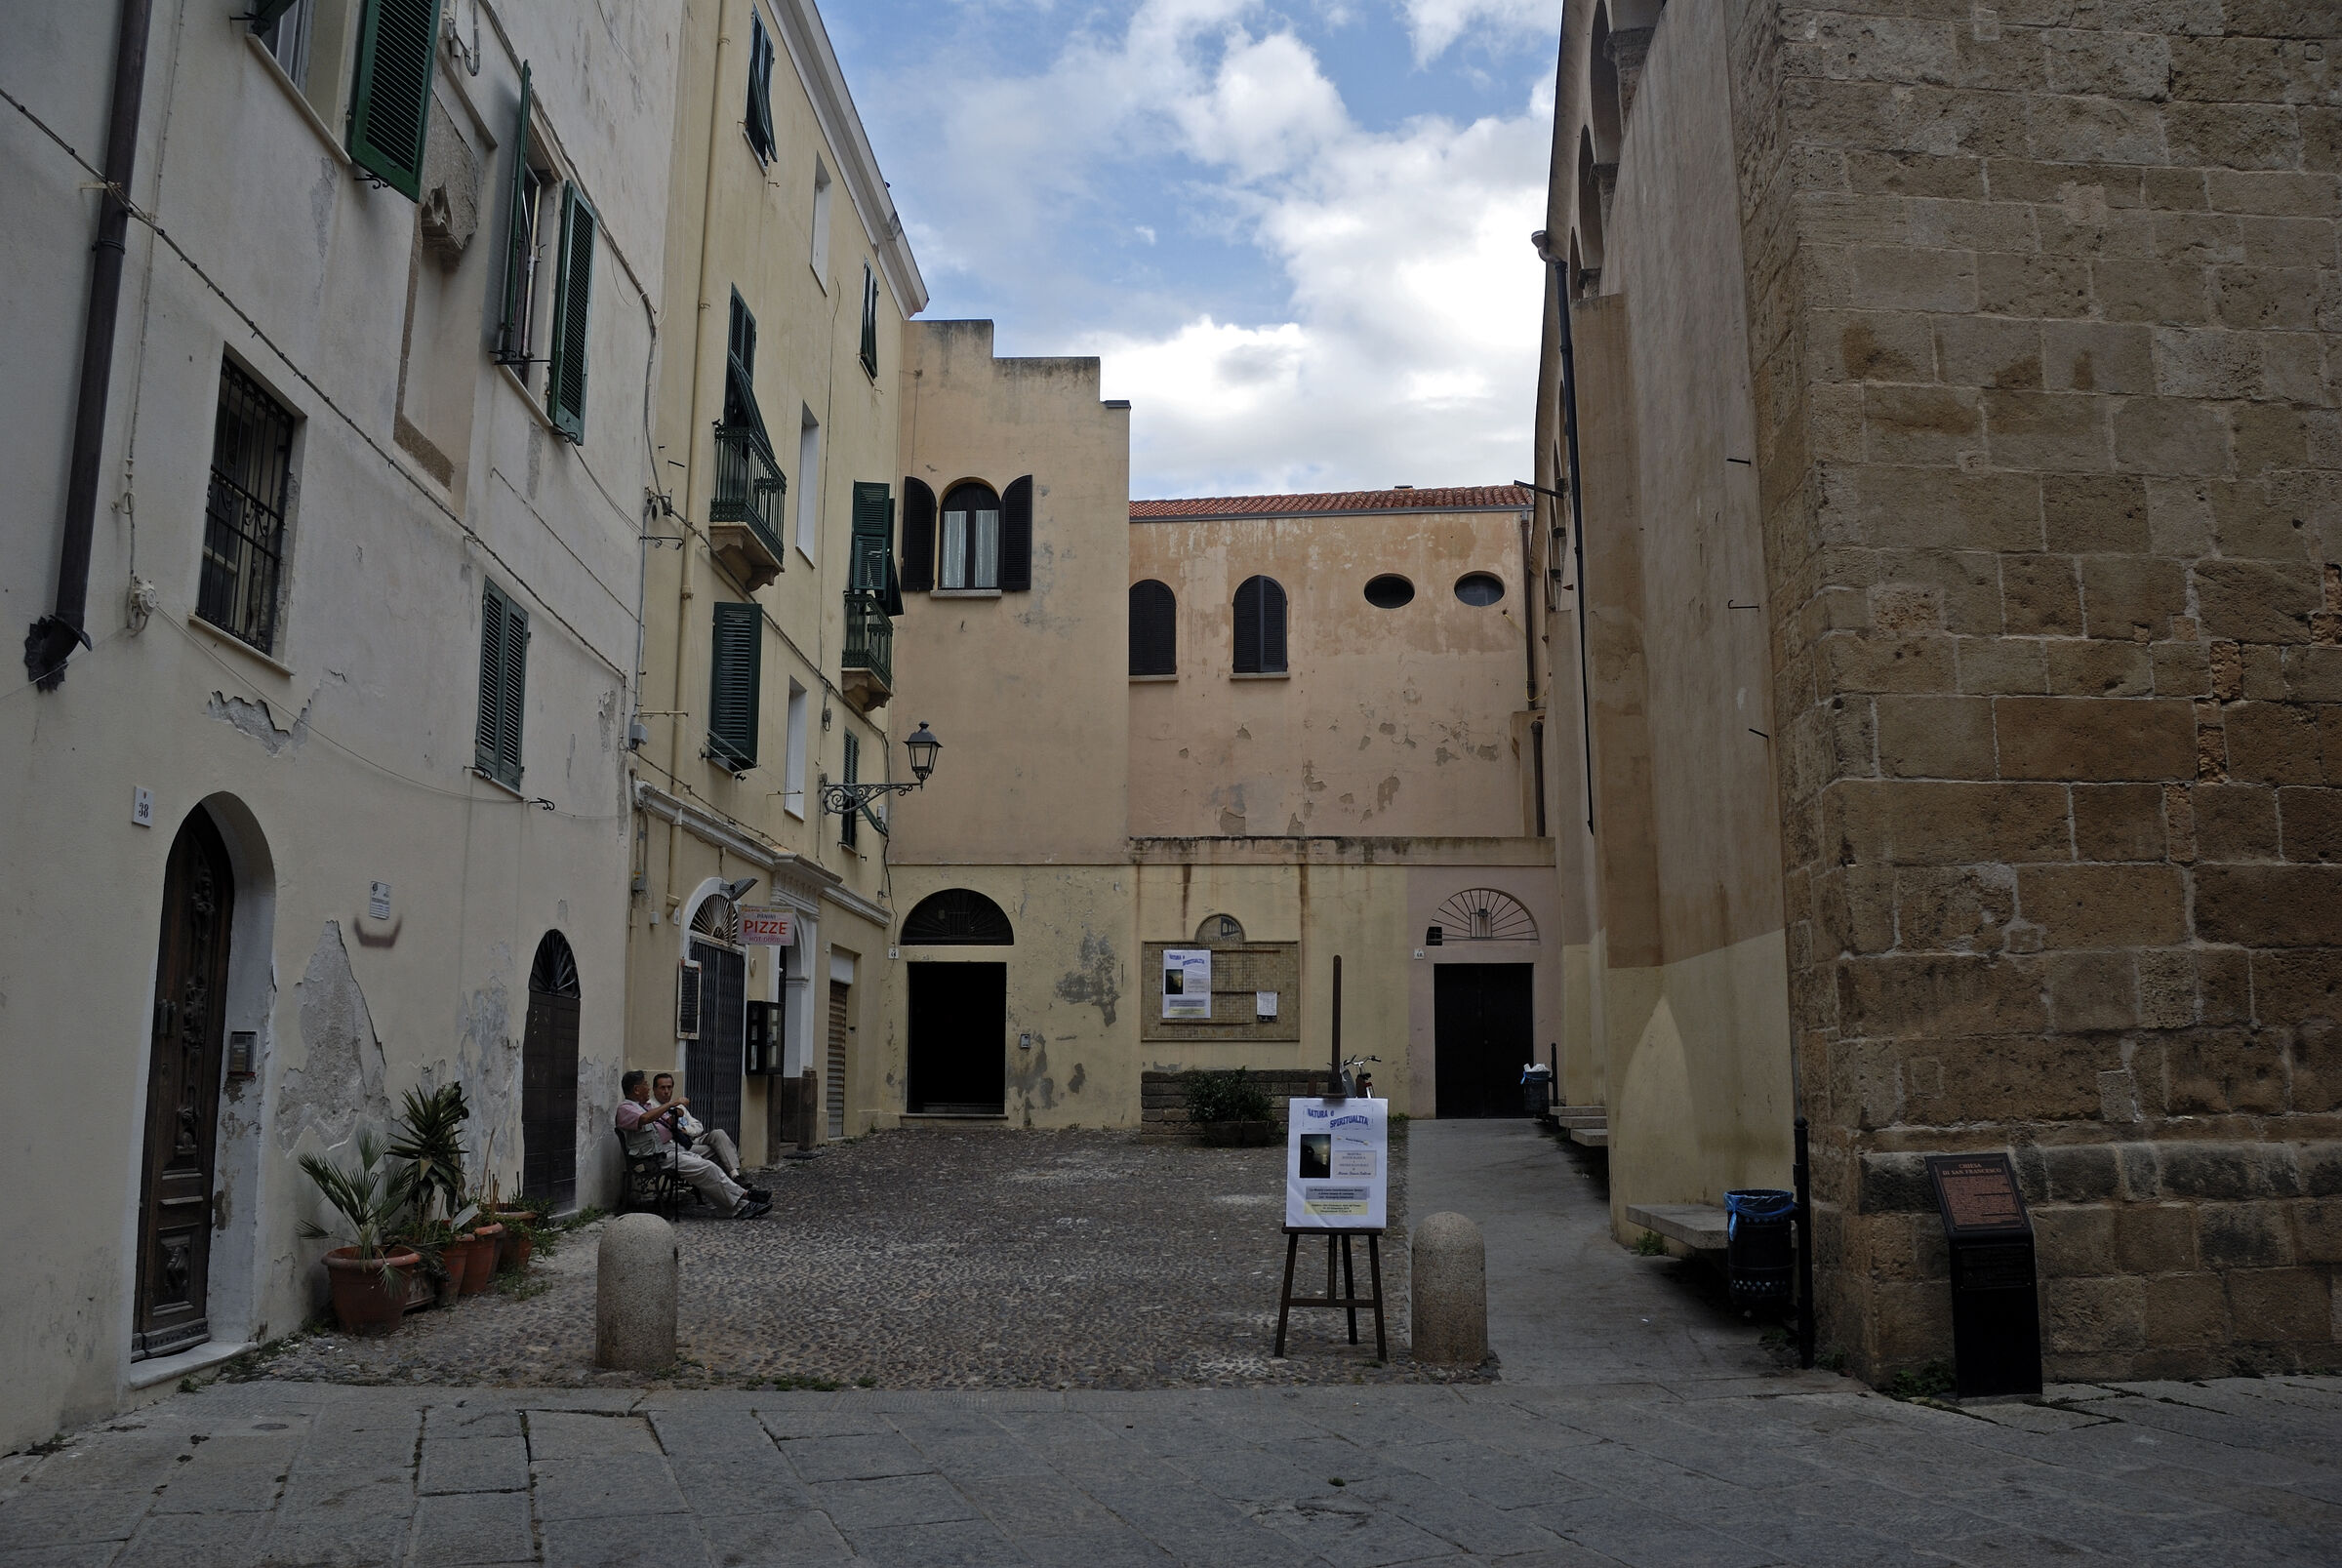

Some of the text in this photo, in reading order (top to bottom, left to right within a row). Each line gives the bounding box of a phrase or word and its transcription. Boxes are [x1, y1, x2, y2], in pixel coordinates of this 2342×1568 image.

[139, 802, 149, 819] 38
[744, 920, 788, 935] PIZZE
[1308, 1108, 1328, 1118] NATURA
